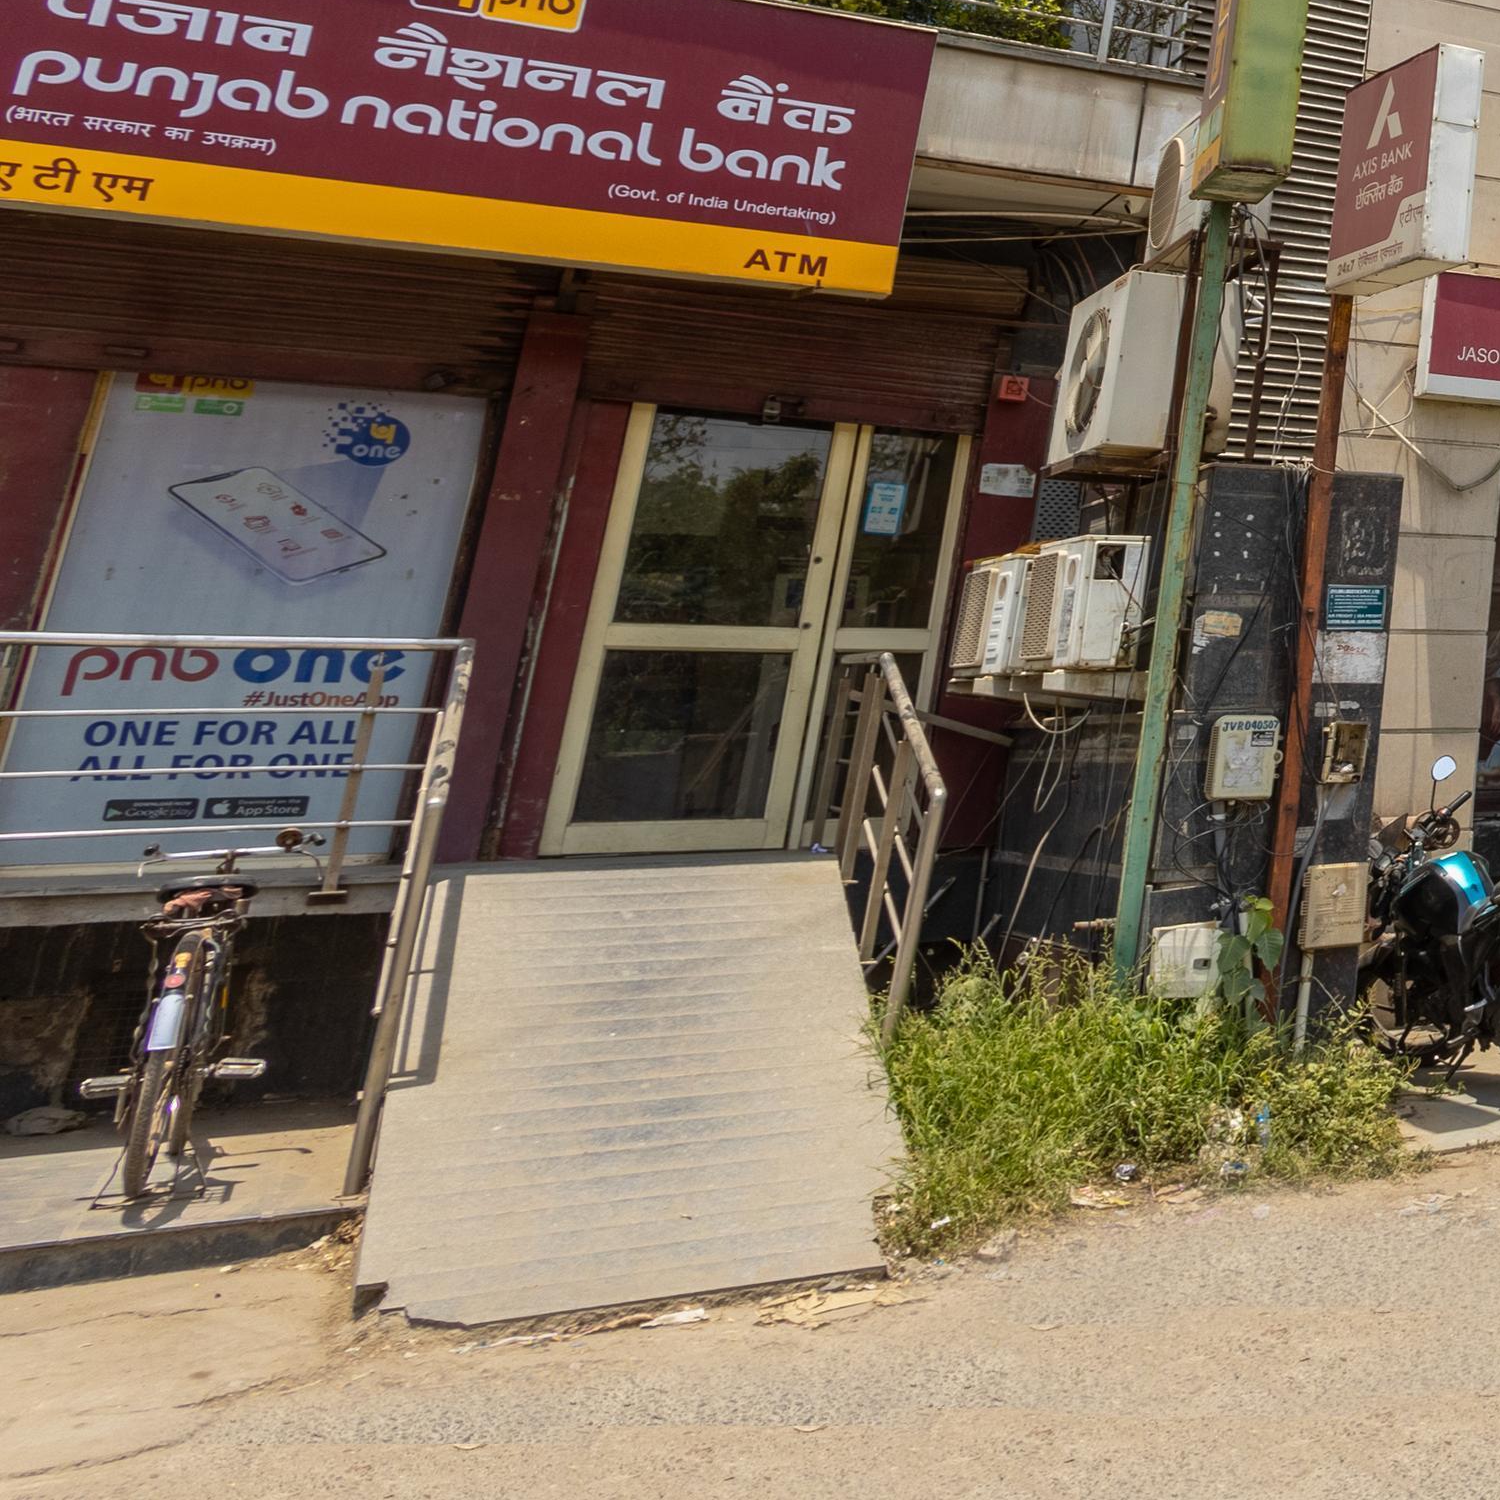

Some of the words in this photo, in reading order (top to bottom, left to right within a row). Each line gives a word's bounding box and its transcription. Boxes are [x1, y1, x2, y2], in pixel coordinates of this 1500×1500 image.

[374, 21, 665, 109] नैशनल
[717, 74, 856, 135] बैंक
[5, 105, 74, 126] (भारत
[83, 115, 156, 137] सरकार
[164, 126, 194, 142] का
[202, 131, 277, 155] उपक्रम)
[12, 50, 329, 119] punjab
[340, 95, 662, 166] national
[678, 127, 846, 191] bank
[33, 157, 80, 193] टी
[91, 171, 154, 202] एम
[1352, 156, 1377, 182] AXIS
[1381, 140, 1414, 171] BANK
[608, 183, 660, 202] (Govt.
[666, 192, 683, 204] of
[688, 194, 728, 210] India
[734, 199, 836, 225] Undertaking)
[744, 249, 828, 277] ATM
[60, 648, 219, 696] pnb
[83, 720, 188, 747] ONE
[193, 720, 277, 747] FOR
[287, 720, 357, 745] ALL
[69, 755, 152, 782] ALL
[168, 753, 254, 780] FOR
[268, 752, 354, 779] ONE
[170, 807, 194, 817] play
[235, 805, 264, 817] App
[264, 805, 300, 815] Store
